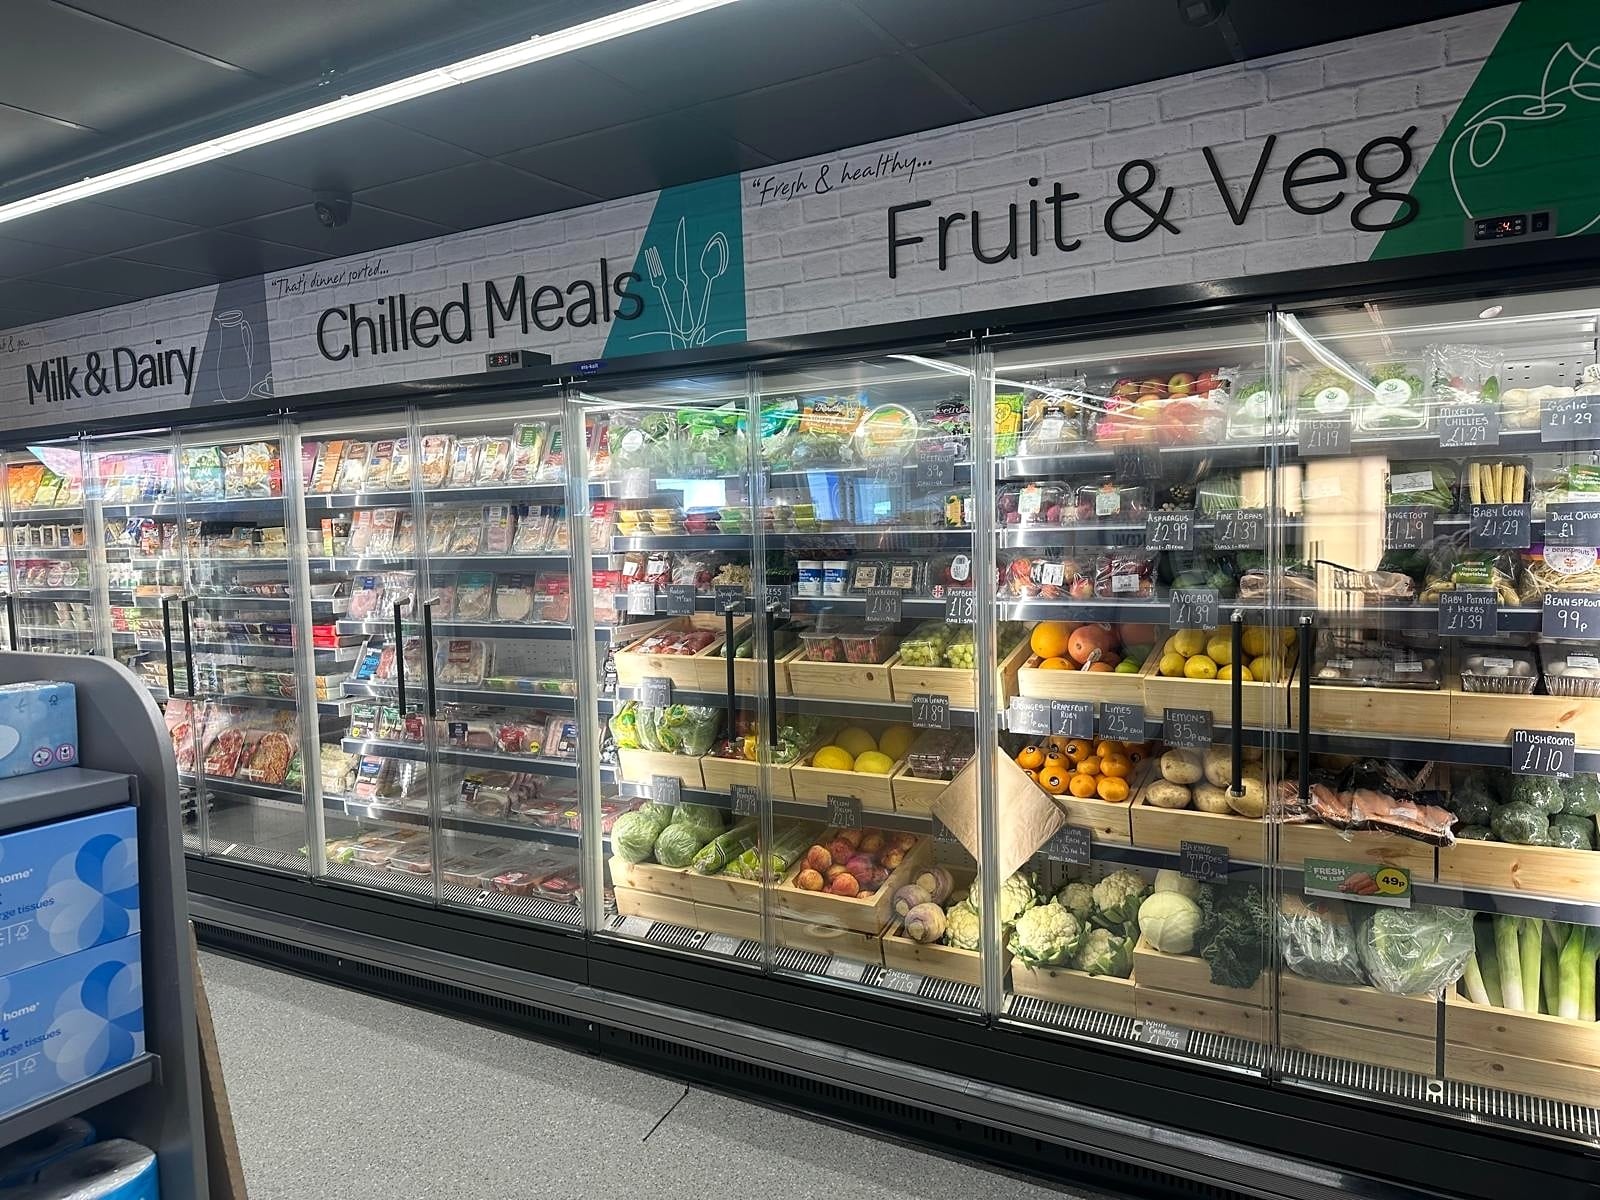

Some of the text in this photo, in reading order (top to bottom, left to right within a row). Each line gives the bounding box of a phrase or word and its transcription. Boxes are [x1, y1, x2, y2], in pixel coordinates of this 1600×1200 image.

[815, 165, 833, 194] &
[841, 152, 932, 183] healthy...
[888, 126, 1419, 278] Fruit & Veg
[310, 271, 345, 288] dinner
[316, 257, 644, 362] Chilled Meals
[27, 339, 197, 405] Milk & Dairy
[1440, 408, 1474, 418] MIXED
[1445, 416, 1489, 426] CHILLIES
[1147, 513, 1189, 523] ASPARAGUS
[1216, 510, 1263, 521] FINE BEANS
[1472, 505, 1524, 518] BABY CORN
[1559, 522, 1574, 538] £1
[1441, 593, 1497, 605] BABY POTATOES
[1458, 605, 1485, 613] HERBS
[1060, 711, 1077, 719] RUBY
[1104, 703, 1131, 714] LIMES
[1166, 709, 1205, 723] LEMONS
[1058, 719, 1073, 735] £1
[1515, 730, 1575, 746] MUSHROOMS
[1313, 867, 1345, 876] FRESH
[1381, 876, 1405, 888] 49p
[18, 896, 55, 914] tissues
[887, 968, 912, 980] SWEDE
[4, 1004, 36, 1021] home
[24, 1028, 62, 1048] tissues
